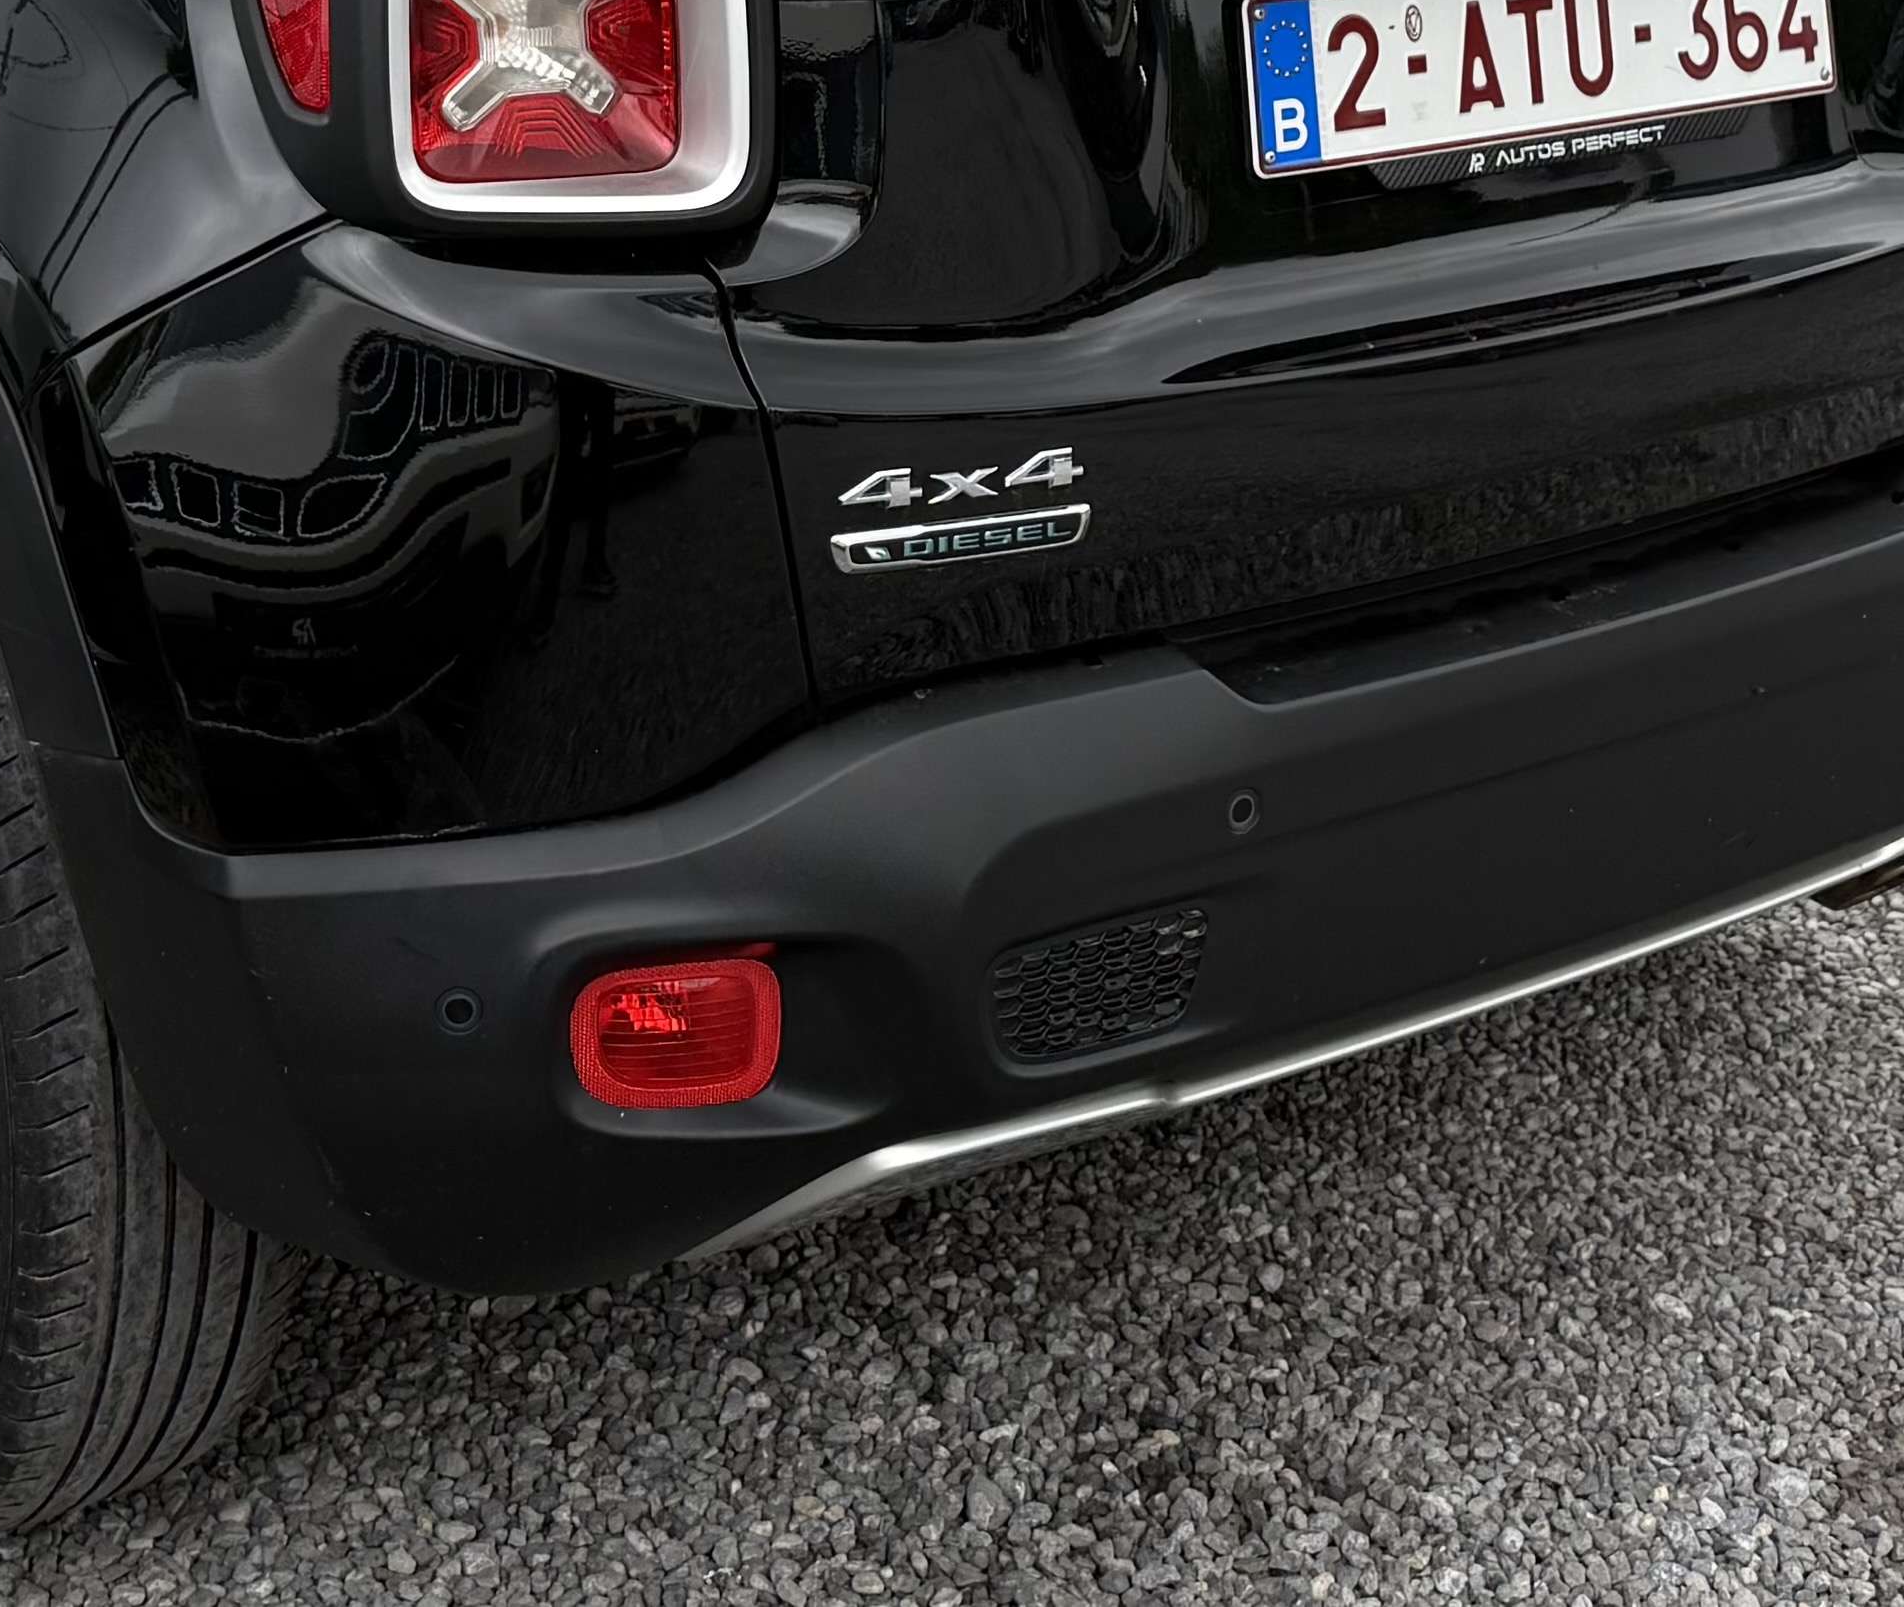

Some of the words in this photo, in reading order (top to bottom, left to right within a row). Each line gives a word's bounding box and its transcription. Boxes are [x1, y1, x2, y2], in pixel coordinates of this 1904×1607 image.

[1273, 98, 1308, 156] B
[1496, 141, 1566, 167] AUTOS
[1571, 125, 1666, 155] PERFECT
[904, 521, 1072, 558] DIESEL
